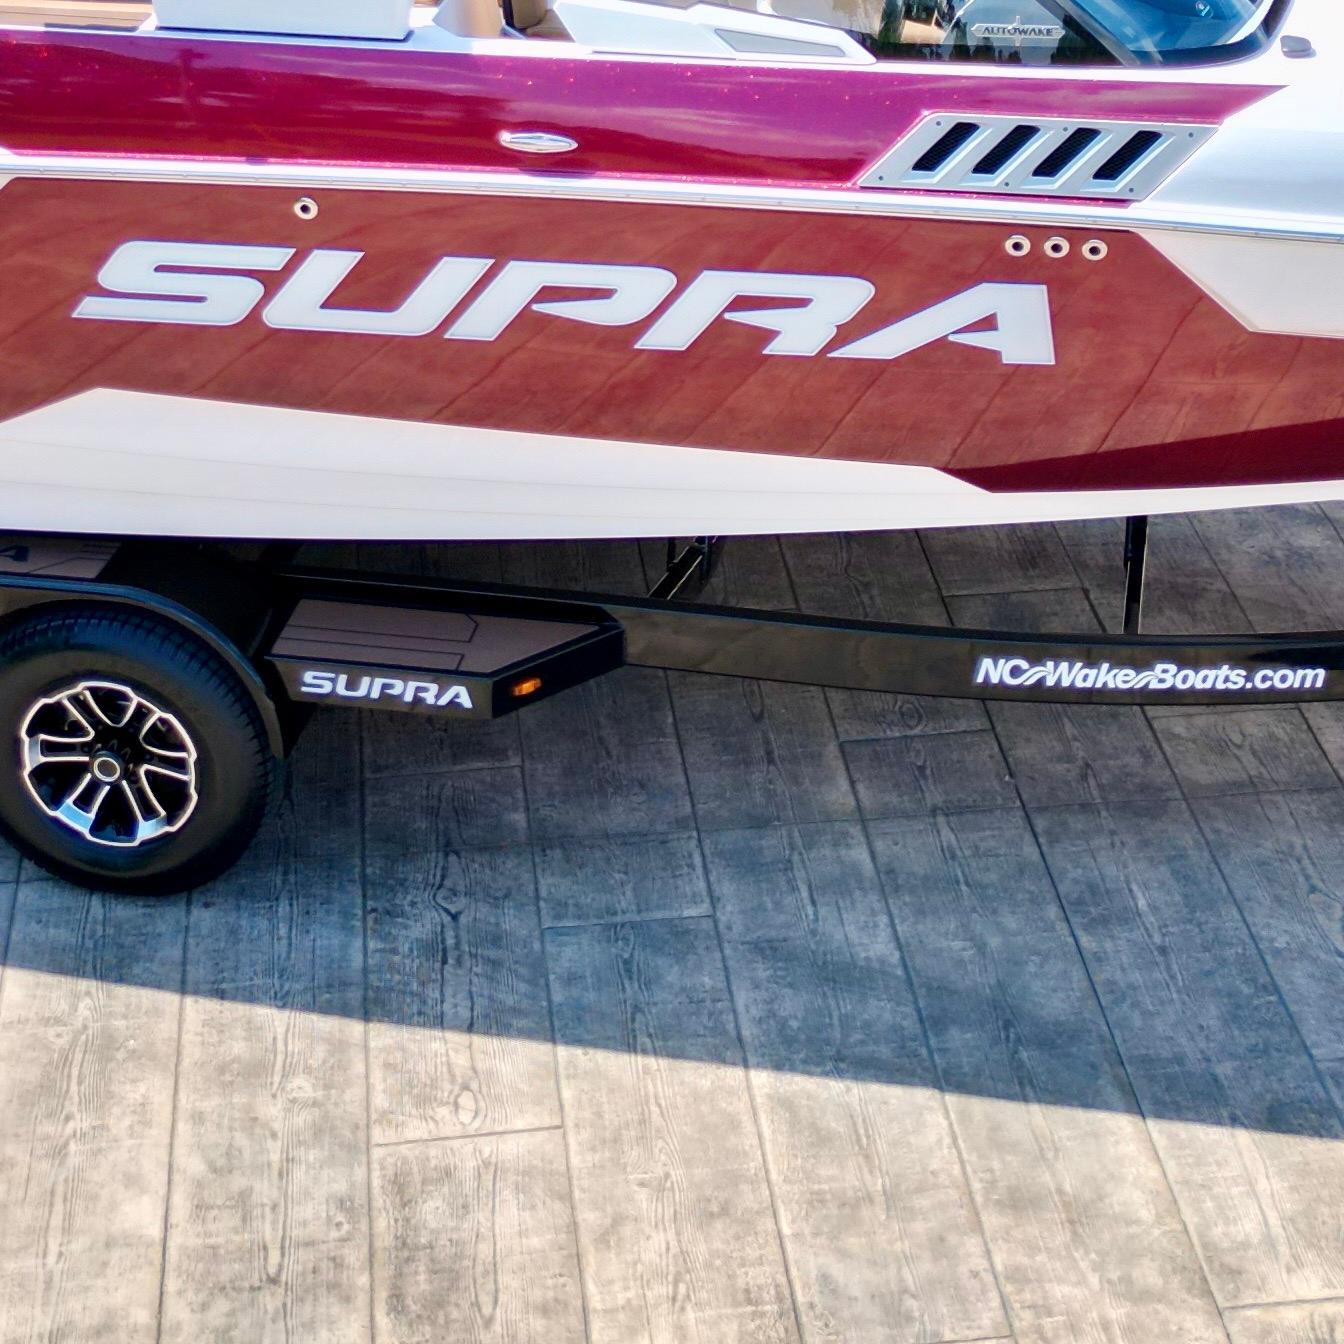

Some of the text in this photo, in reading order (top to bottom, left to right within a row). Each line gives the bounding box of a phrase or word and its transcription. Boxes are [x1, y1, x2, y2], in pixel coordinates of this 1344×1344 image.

[982, 26, 1054, 36] AUTOWAKE
[71, 239, 1056, 366] SUPRA
[299, 669, 474, 710] SUPRA
